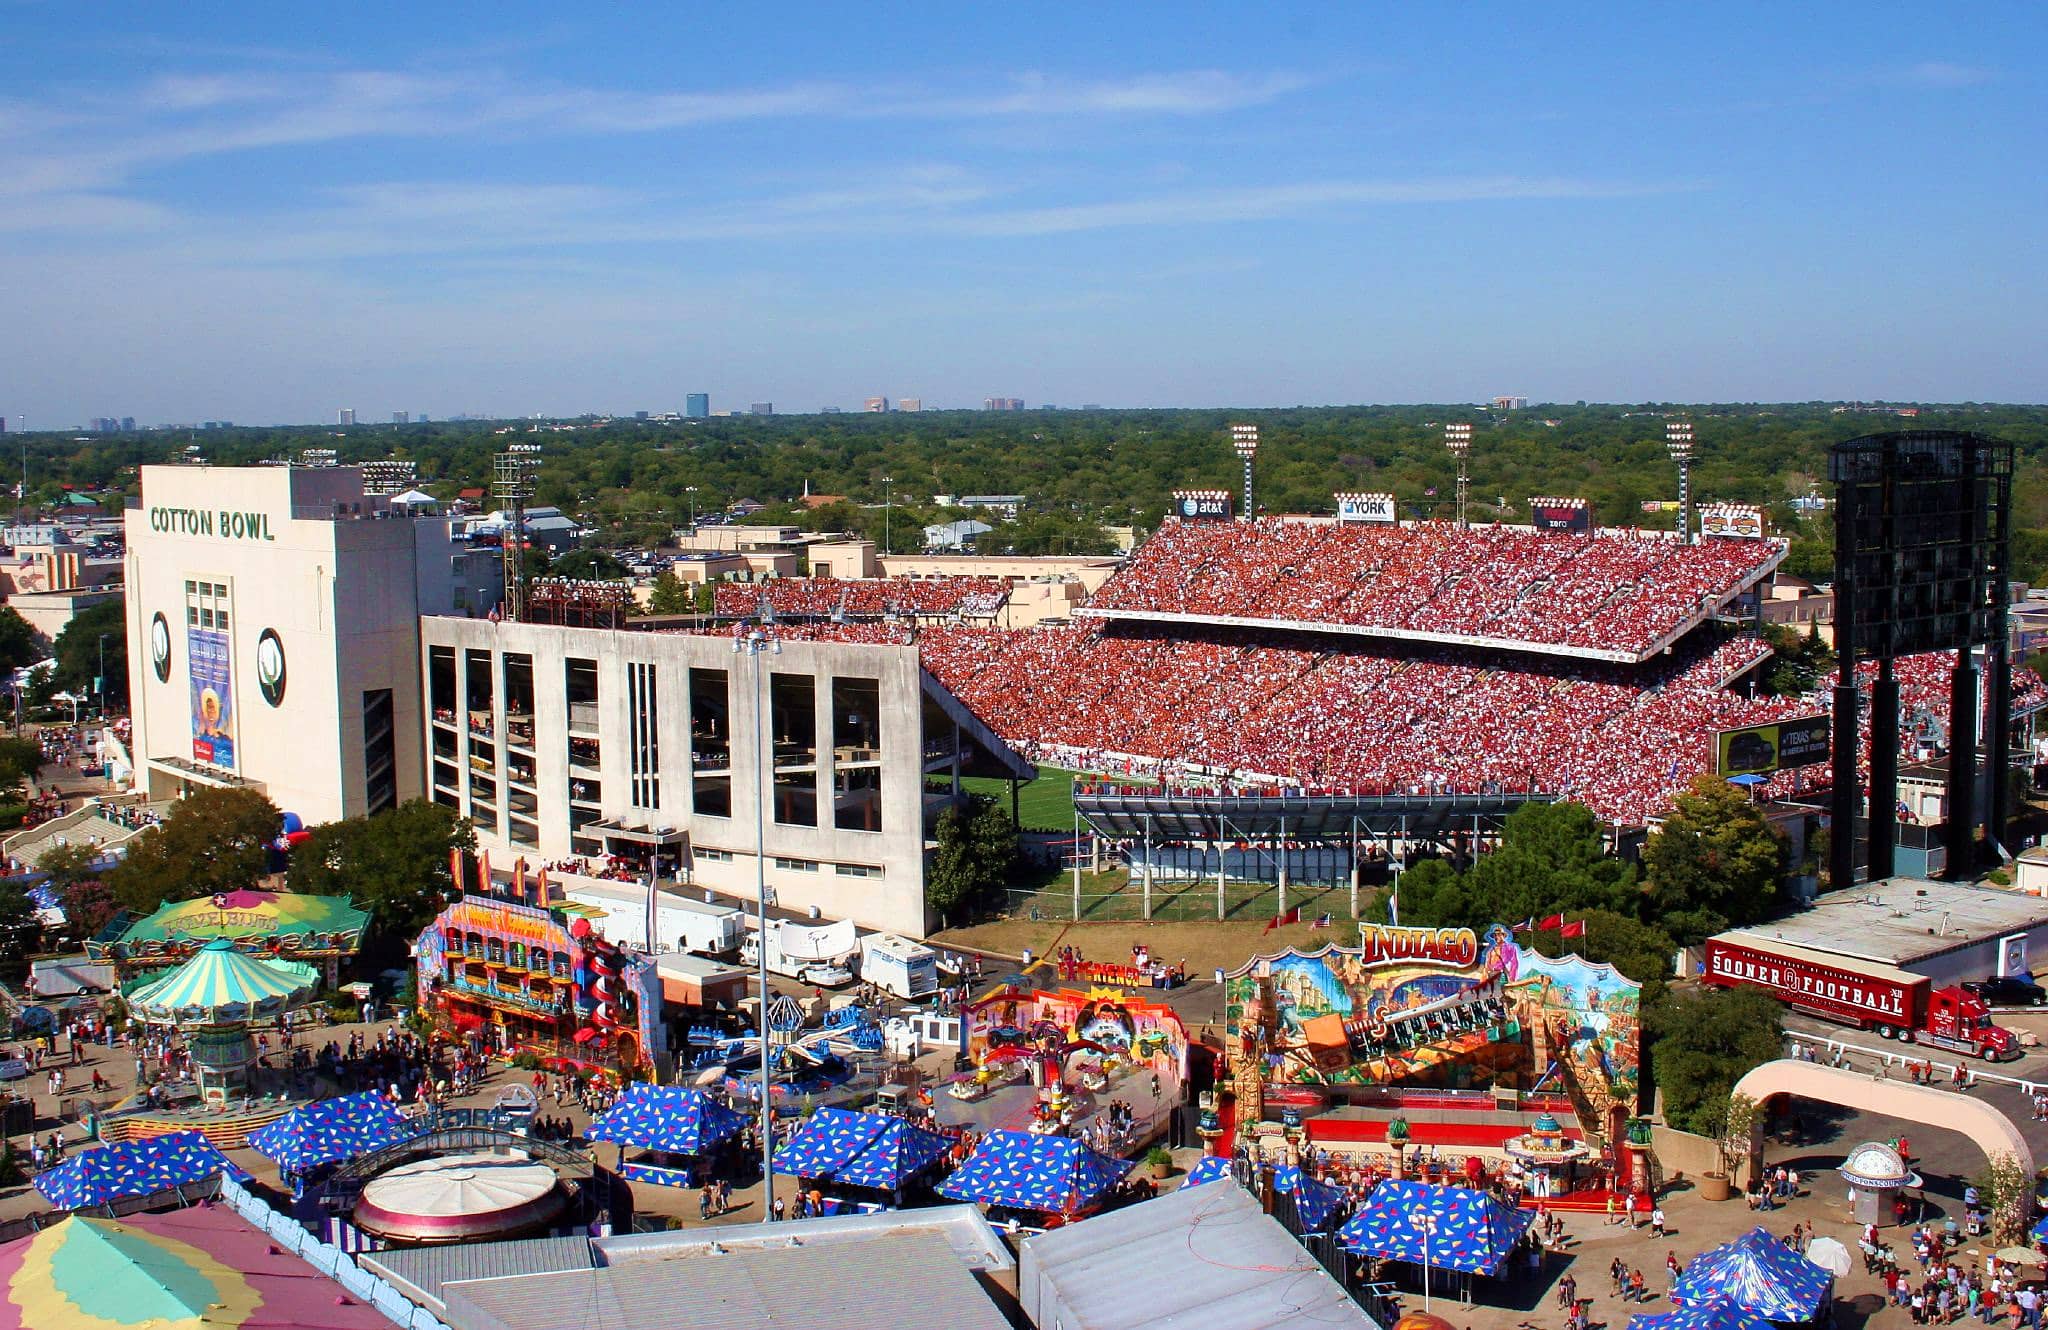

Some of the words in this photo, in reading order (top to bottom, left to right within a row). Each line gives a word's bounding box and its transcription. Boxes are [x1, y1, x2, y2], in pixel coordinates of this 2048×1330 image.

[1200, 501, 1223, 513] at&t
[1354, 502, 1386, 514] YORK
[151, 506, 213, 536] COTTON
[220, 511, 275, 541] BOWL
[1787, 730, 1810, 745] TEXAS
[1360, 924, 1476, 966] INDIAGO
[1057, 961, 1140, 988] EPERIENCE
[1713, 955, 1780, 985] SOONER
[1804, 976, 1903, 1014] FOOTBALL
